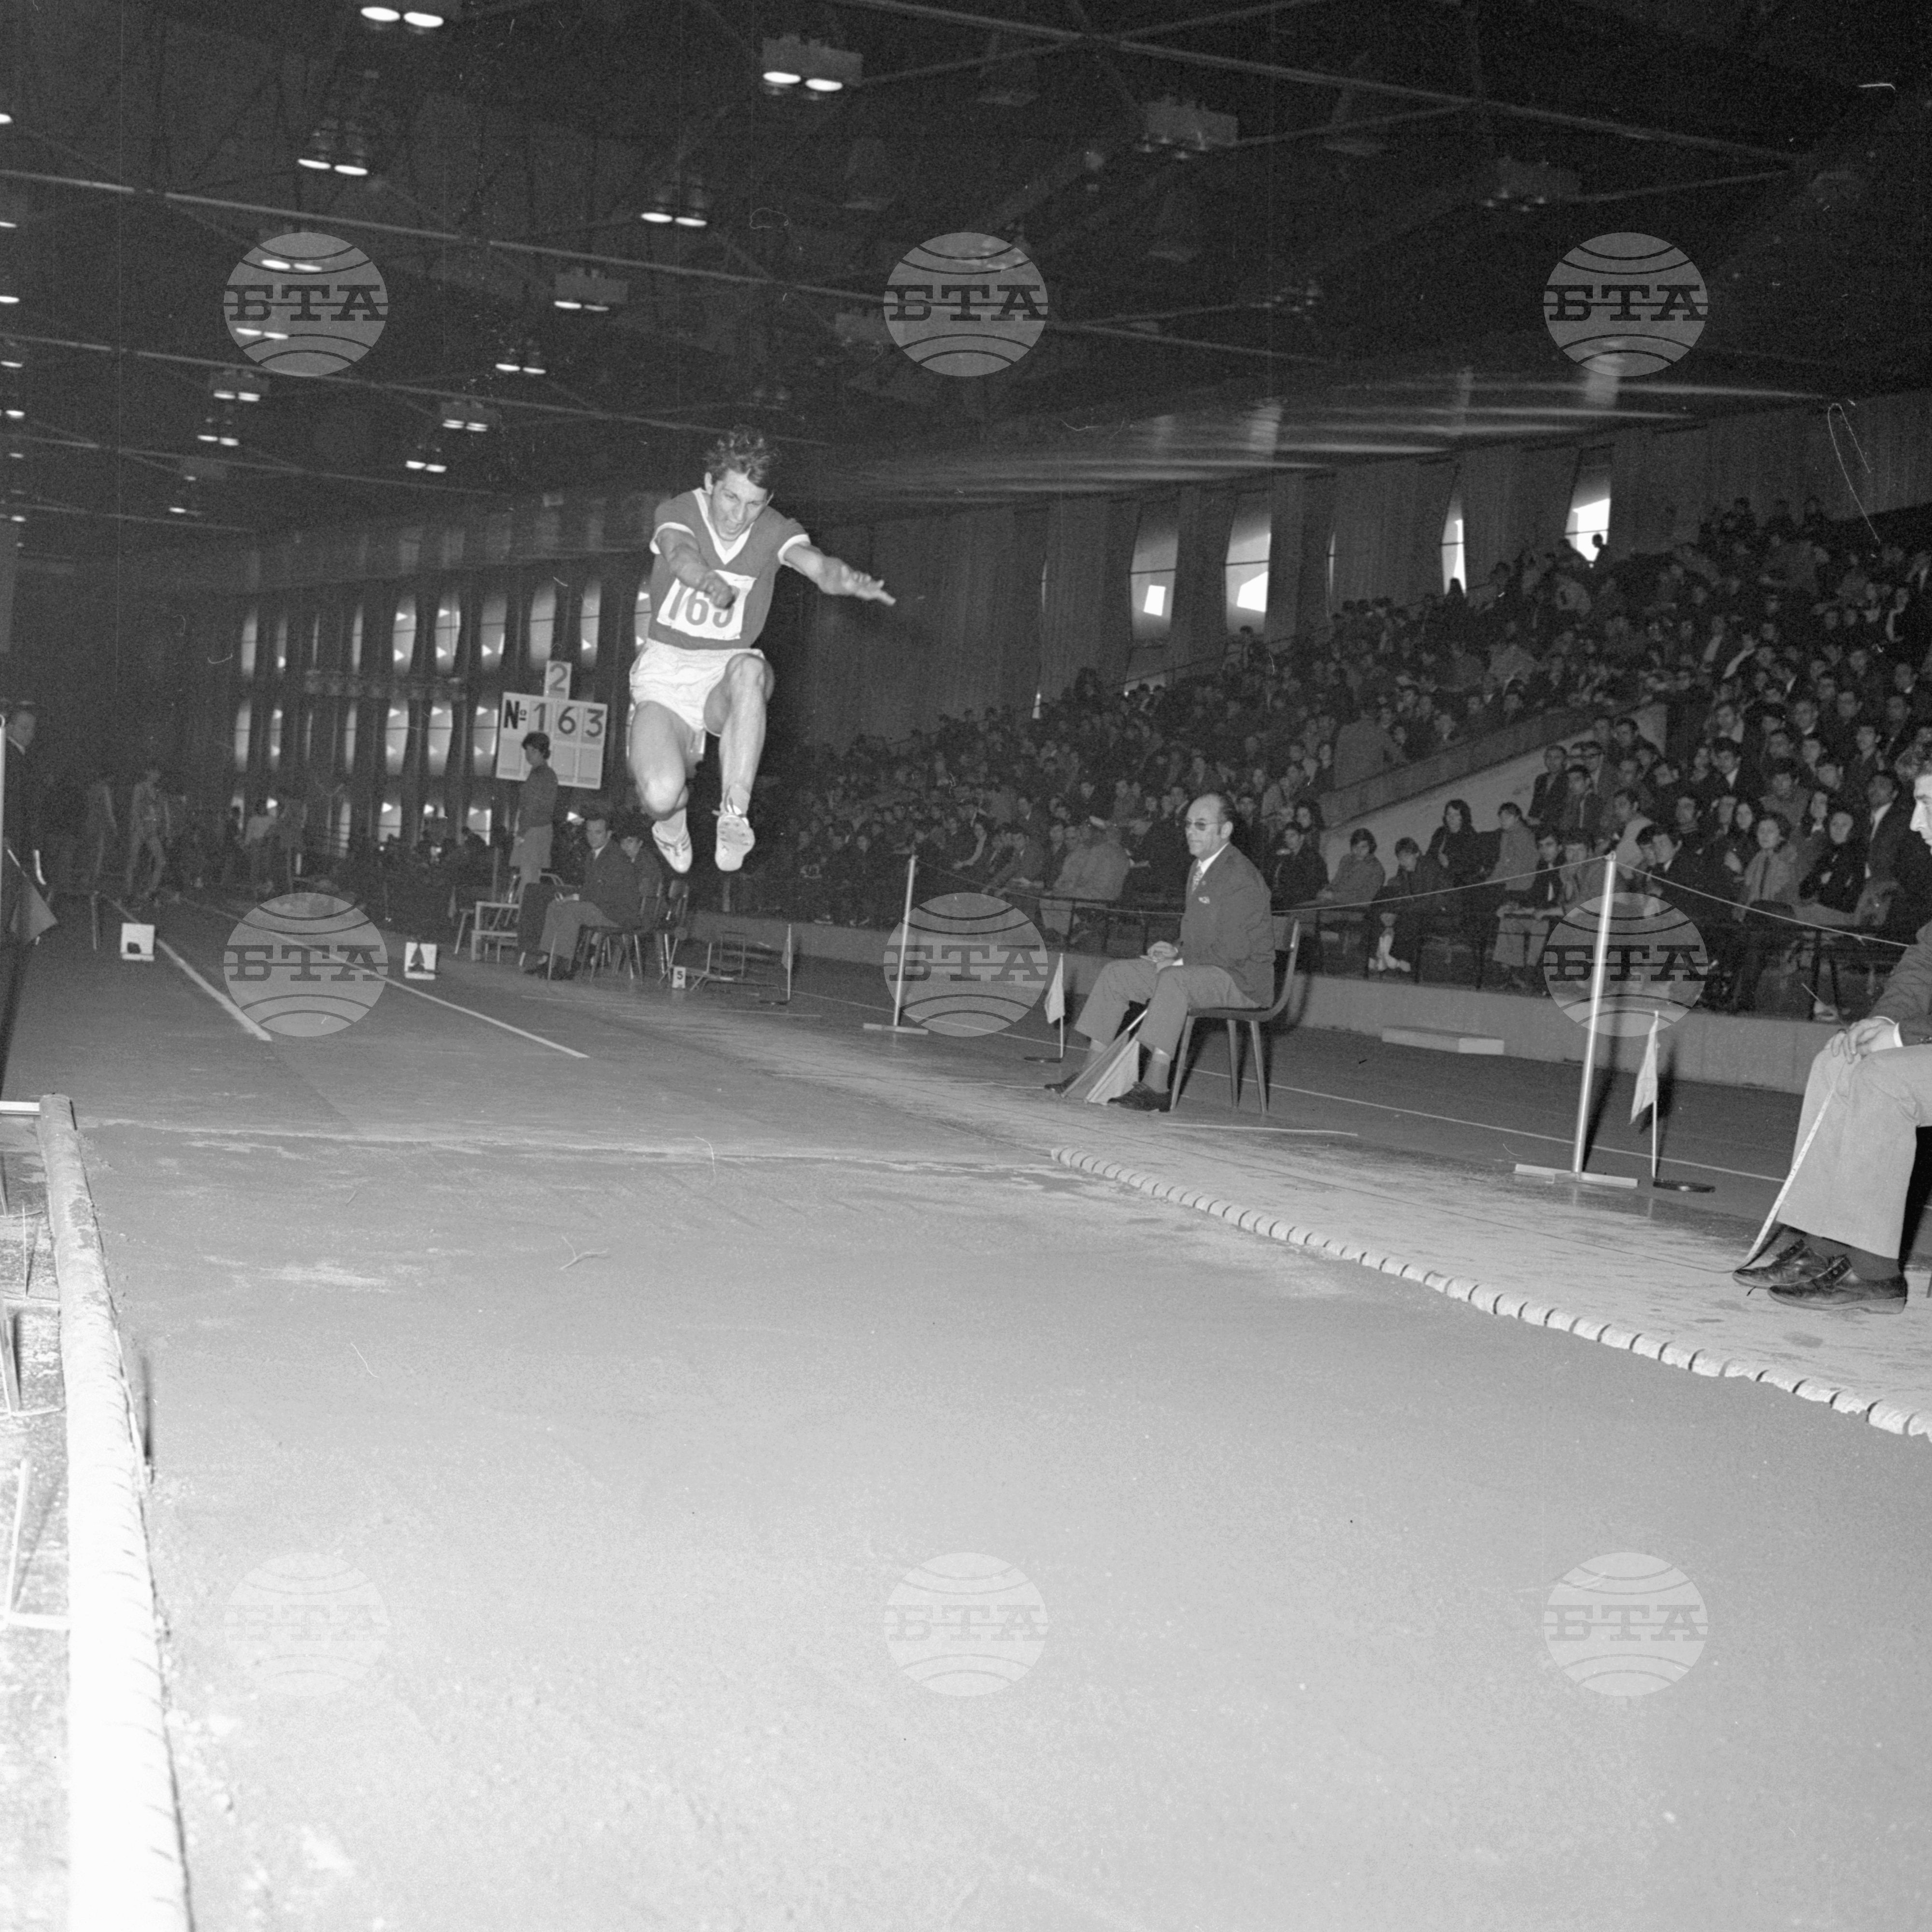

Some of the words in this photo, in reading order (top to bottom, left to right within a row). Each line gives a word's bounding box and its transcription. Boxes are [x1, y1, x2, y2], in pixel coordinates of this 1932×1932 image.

[549, 663, 568, 692] 2
[533, 703, 604, 738] 163
[677, 971, 683, 980] 5
